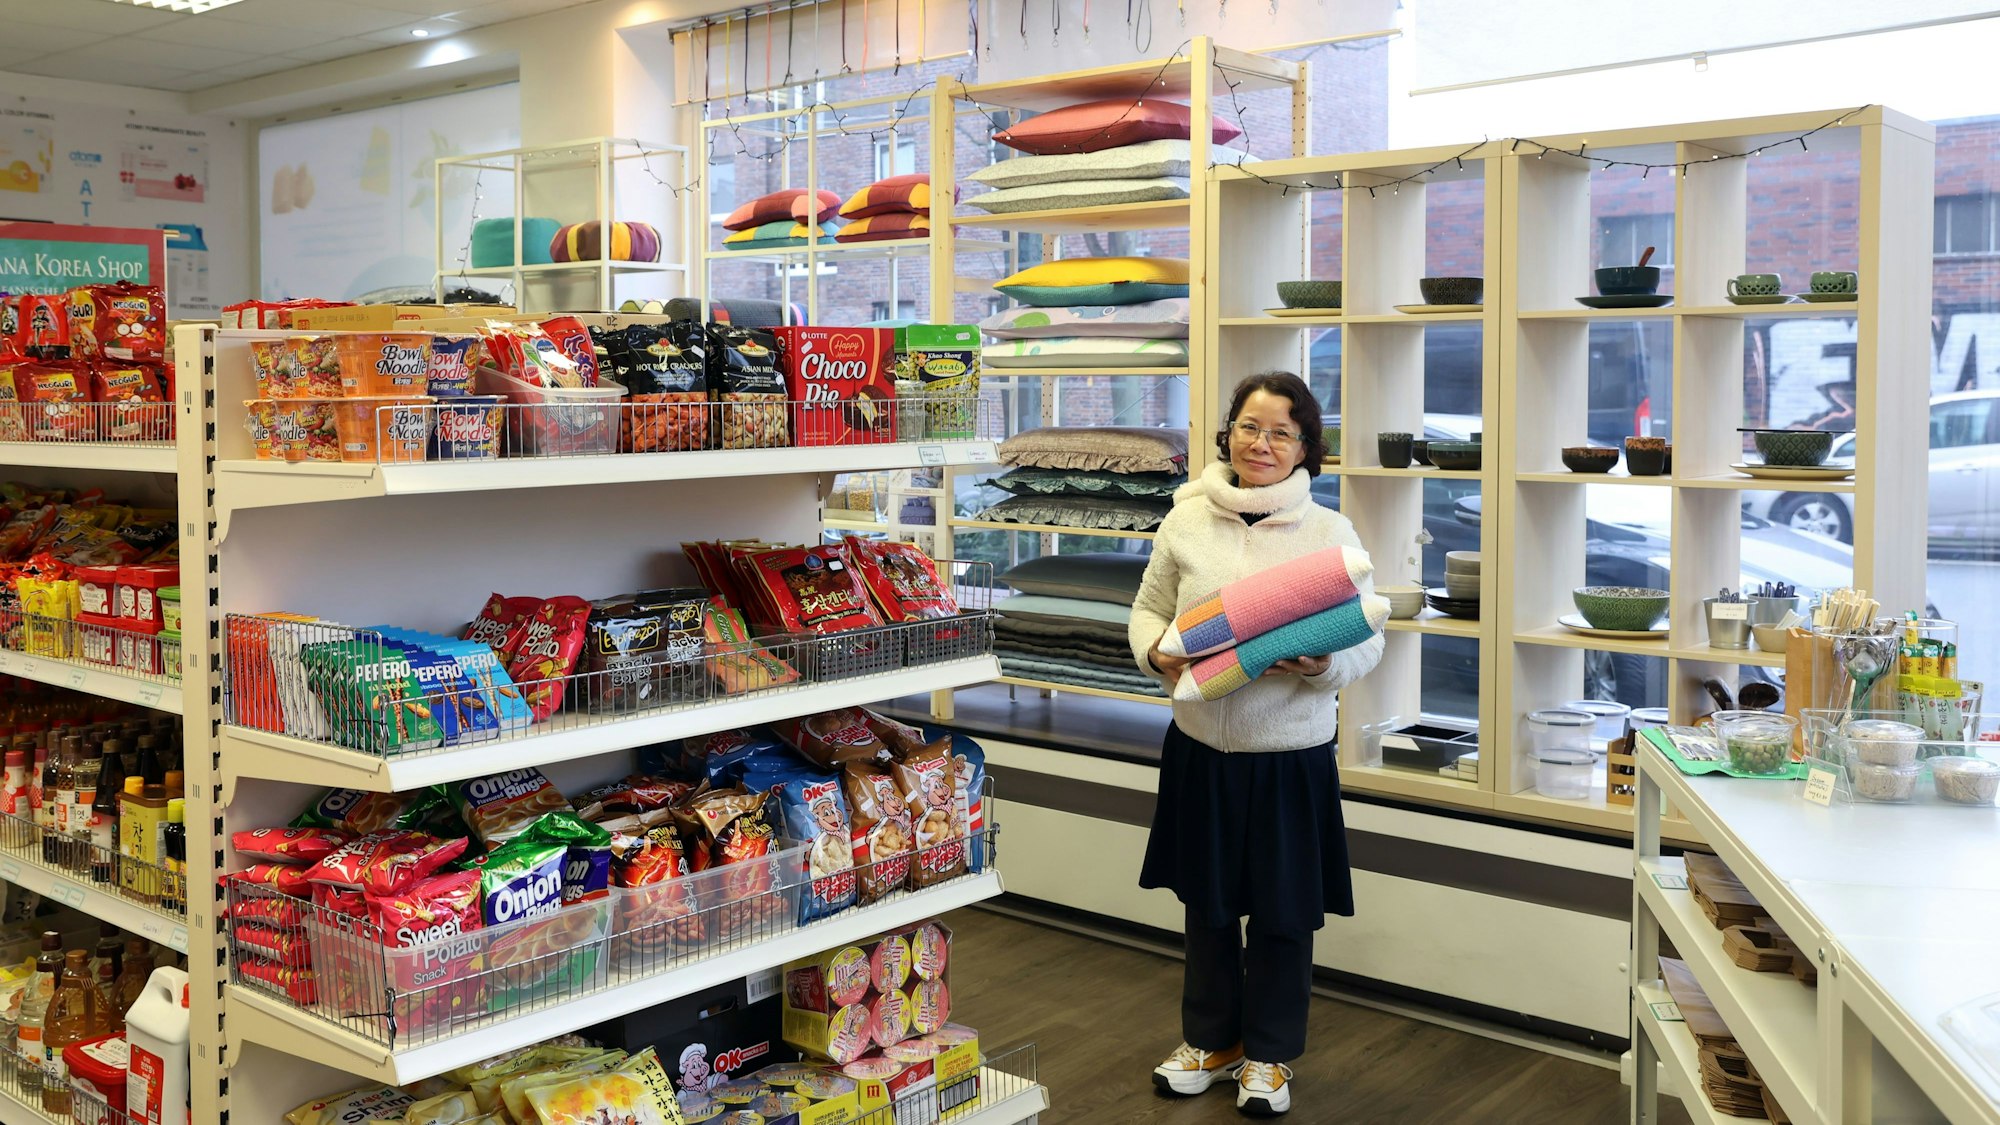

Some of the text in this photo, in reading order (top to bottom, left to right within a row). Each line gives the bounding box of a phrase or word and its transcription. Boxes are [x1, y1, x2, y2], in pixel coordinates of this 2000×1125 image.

[35, 253, 92, 277] KOREA
[98, 256, 143, 279] SHOP
[68, 303, 93, 317] GURI
[113, 301, 147, 310] NEOGURI
[382, 345, 424, 361] Bowl
[834, 339, 859, 351] Happy
[599, 360, 612, 368] ICE
[944, 352, 962, 360] Shong
[376, 359, 427, 375] Noodle
[429, 364, 469, 380] oodle
[636, 363, 651, 371] HOT
[741, 365, 761, 373] ASIAN
[800, 353, 867, 380] Choco
[928, 362, 964, 372] Wasabi
[38, 381, 73, 389] NEOGURI
[107, 374, 141, 388] NEOGURI
[802, 383, 840, 410] Pie
[279, 411, 297, 427] owl
[395, 410, 424, 426] Bow
[440, 410, 484, 428] Bowl
[279, 427, 307, 441] oodle
[388, 424, 425, 440] Noo
[435, 424, 492, 442] Noodle
[800, 589, 850, 615] 홍삼캔디
[526, 619, 558, 640] wee
[668, 635, 701, 649] ack
[356, 659, 411, 683] PEPERO
[456, 653, 497, 671] EPERO
[607, 656, 653, 674] Black
[368, 680, 411, 692] almond
[822, 725, 861, 745] BACON
[840, 729, 871, 745] CRISP
[469, 767, 537, 799] Onion
[505, 775, 548, 801] Rings
[802, 783, 824, 801] OK
[740, 807, 765, 826] HRIMP
[920, 838, 955, 870] BACON
[933, 843, 962, 873] CRISP
[564, 860, 590, 881] on
[873, 850, 910, 881] BACON
[812, 868, 857, 897] BACON
[826, 876, 856, 903] CRISP
[494, 868, 562, 923] Onion
[562, 883, 585, 902] ngs
[396, 914, 462, 949] Sweet
[423, 935, 482, 970] Potato
[413, 965, 447, 985] Snack
[715, 1048, 742, 1073] OK
[326, 1091, 357, 1105] NONGSHIM
